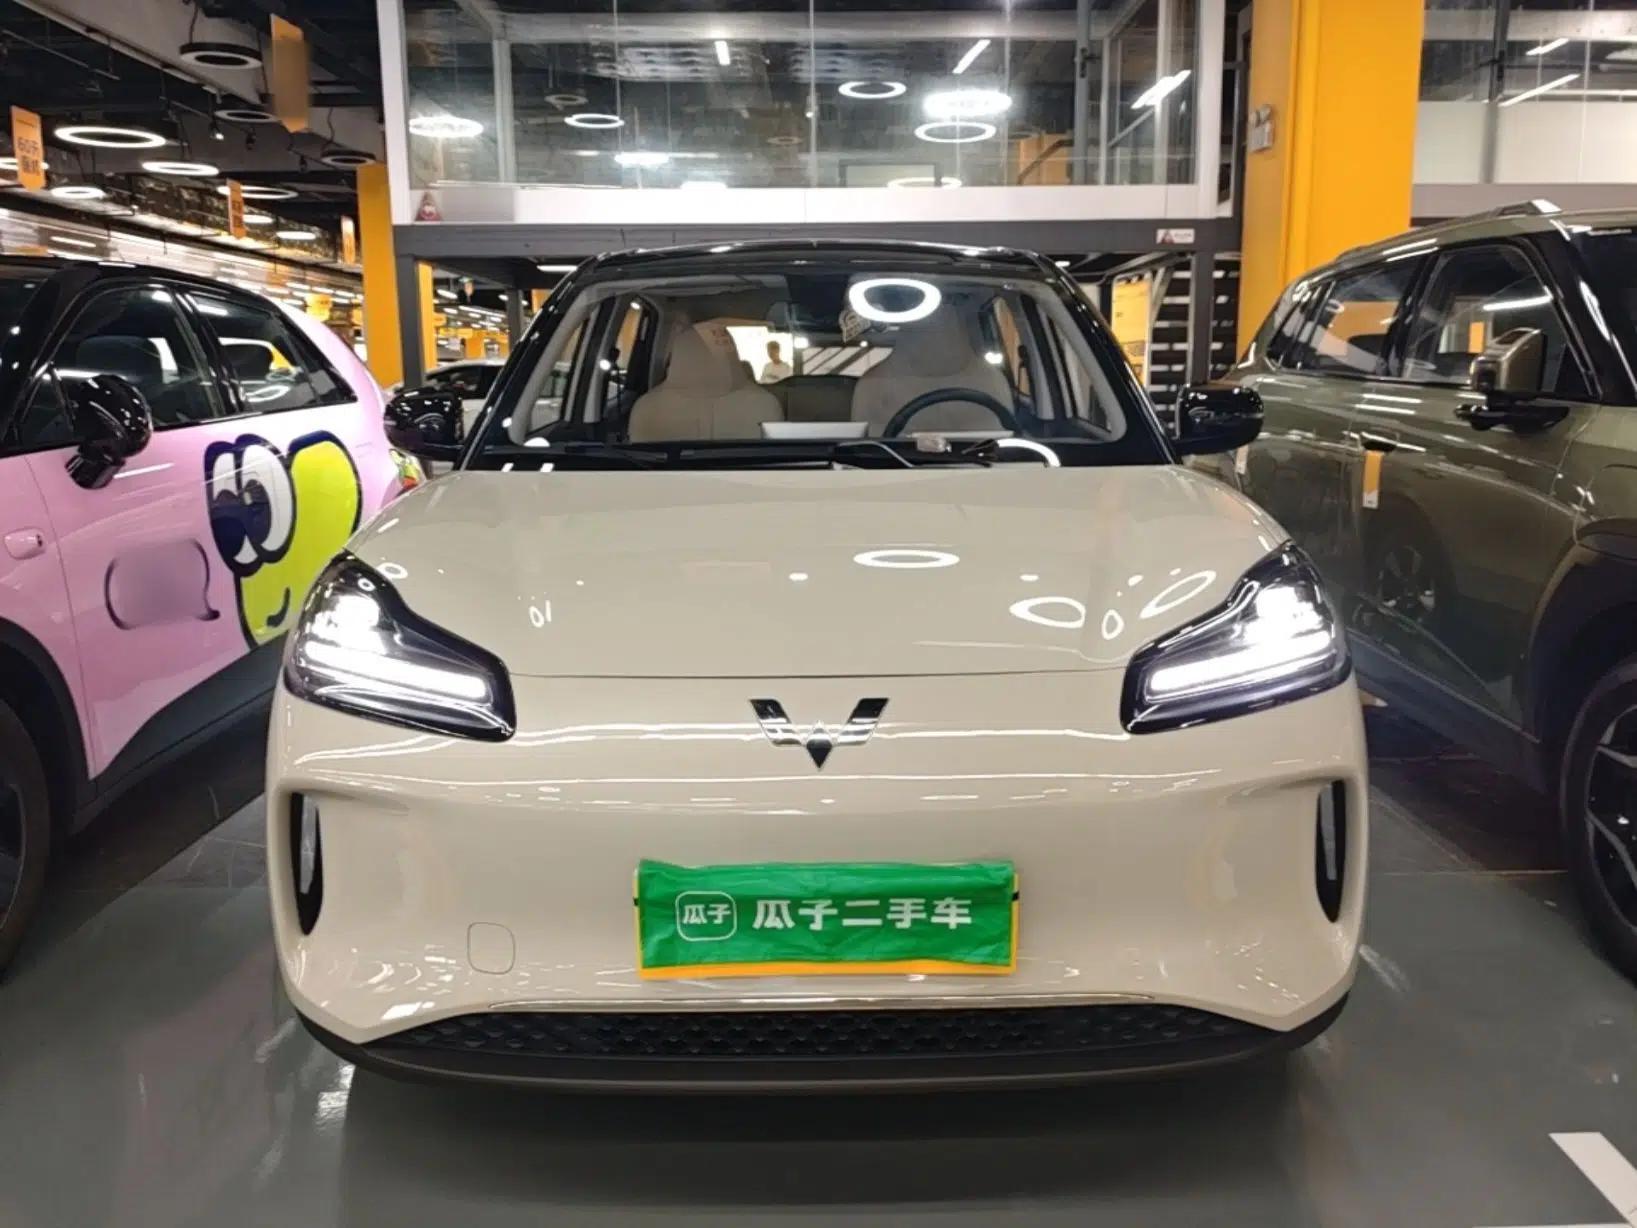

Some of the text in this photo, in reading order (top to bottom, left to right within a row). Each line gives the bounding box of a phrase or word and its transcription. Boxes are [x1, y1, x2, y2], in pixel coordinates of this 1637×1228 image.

[682, 904, 732, 925] 瓜子
[753, 897, 972, 930] 瓜子二手车
